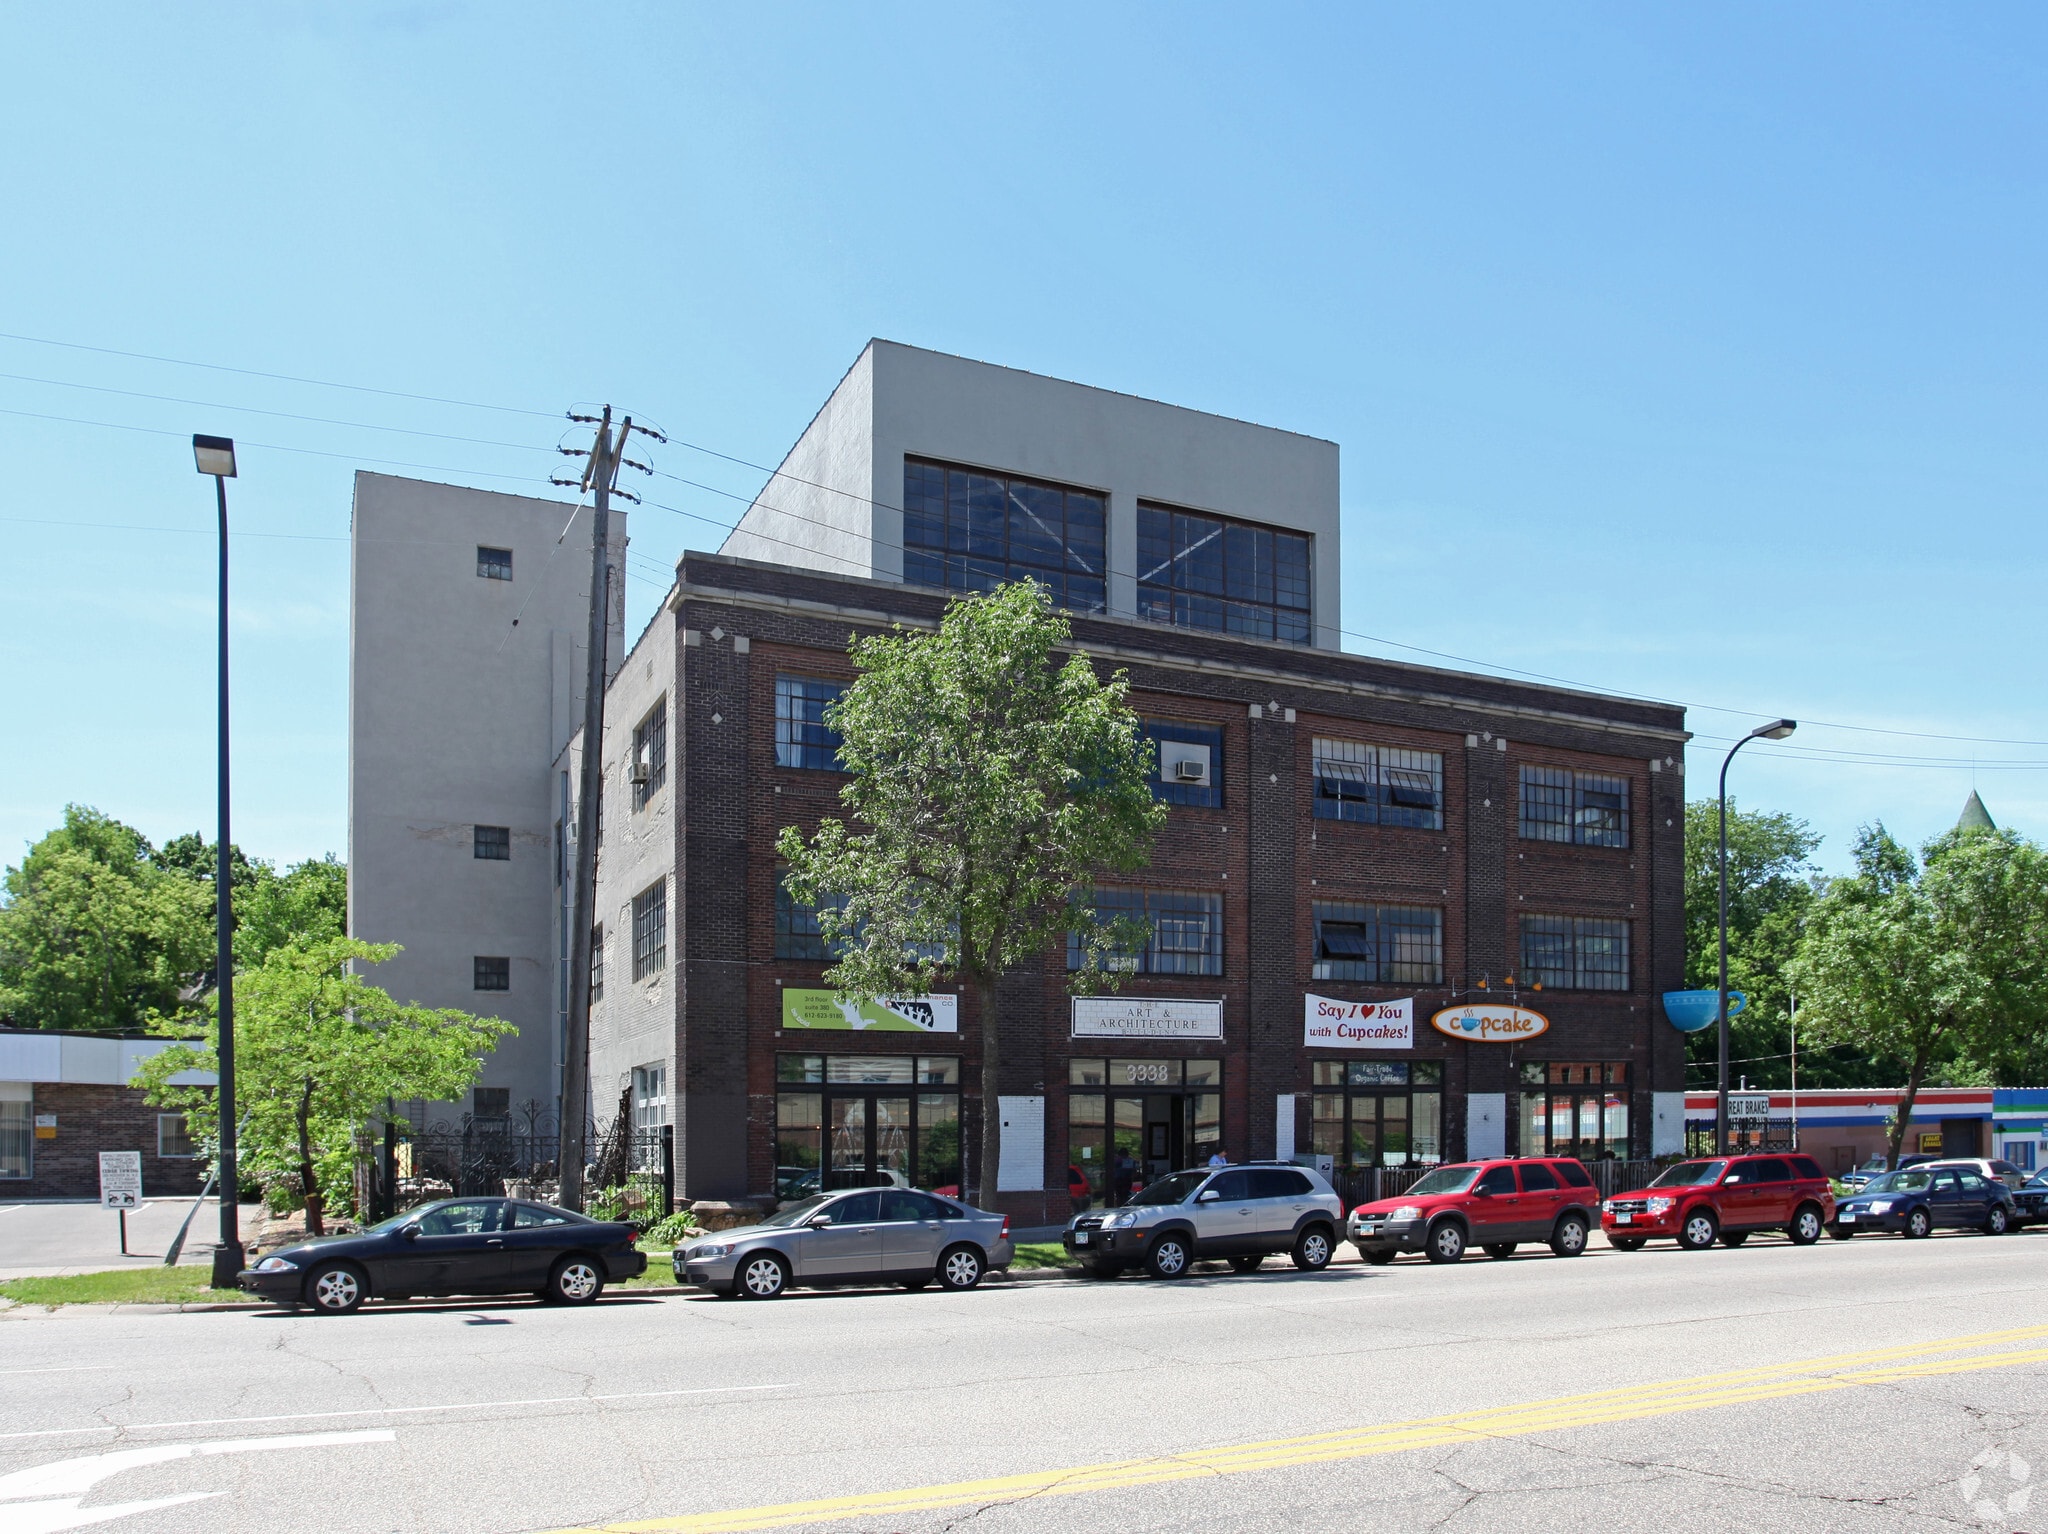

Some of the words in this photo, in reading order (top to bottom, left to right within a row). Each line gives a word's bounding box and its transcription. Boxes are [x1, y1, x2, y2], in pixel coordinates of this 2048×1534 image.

[1127, 1008, 1152, 1018] ART
[1163, 1009, 1171, 1017] &
[1318, 1002, 1345, 1020] Say
[1348, 1005, 1358, 1018] I
[1377, 1005, 1402, 1019] You
[1099, 1018, 1198, 1029] ARCHITECTURE
[1309, 1027, 1331, 1037] with
[1337, 1023, 1408, 1041] Cupcakes!
[1127, 1064, 1168, 1082] 3338
[1362, 1064, 1392, 1073] Fair-Trade
[1355, 1074, 1379, 1084] Organic
[1380, 1074, 1402, 1082] Coffee
[1728, 1101, 1743, 1115] REAT
[1745, 1101, 1768, 1115] BRAKES
